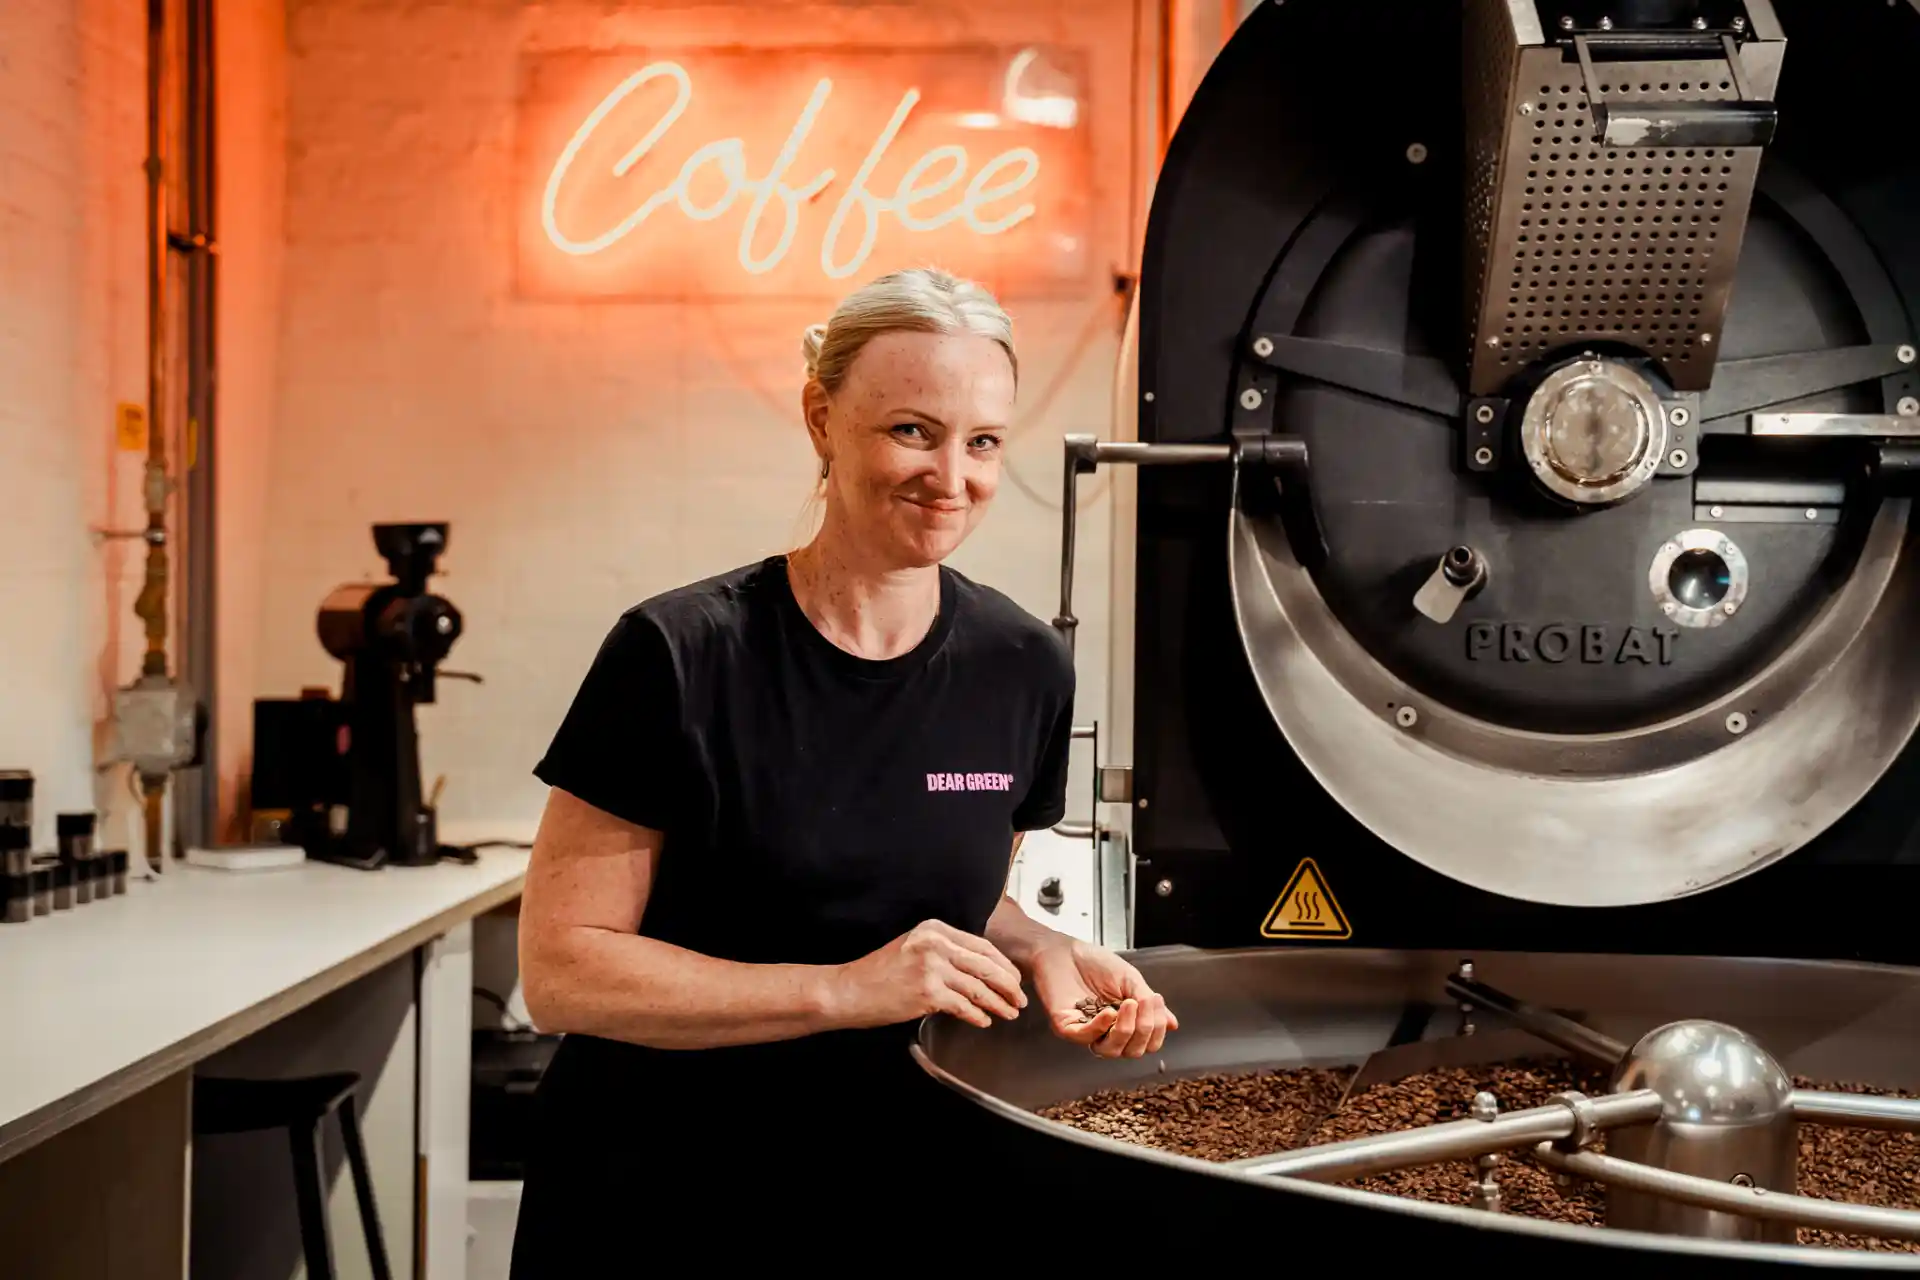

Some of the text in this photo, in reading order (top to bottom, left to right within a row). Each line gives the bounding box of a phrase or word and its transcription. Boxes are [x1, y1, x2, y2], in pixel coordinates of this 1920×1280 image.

[541, 61, 1040, 279] Coffee
[1465, 622, 1679, 665] PROBAT
[926, 772, 965, 792] DEAR
